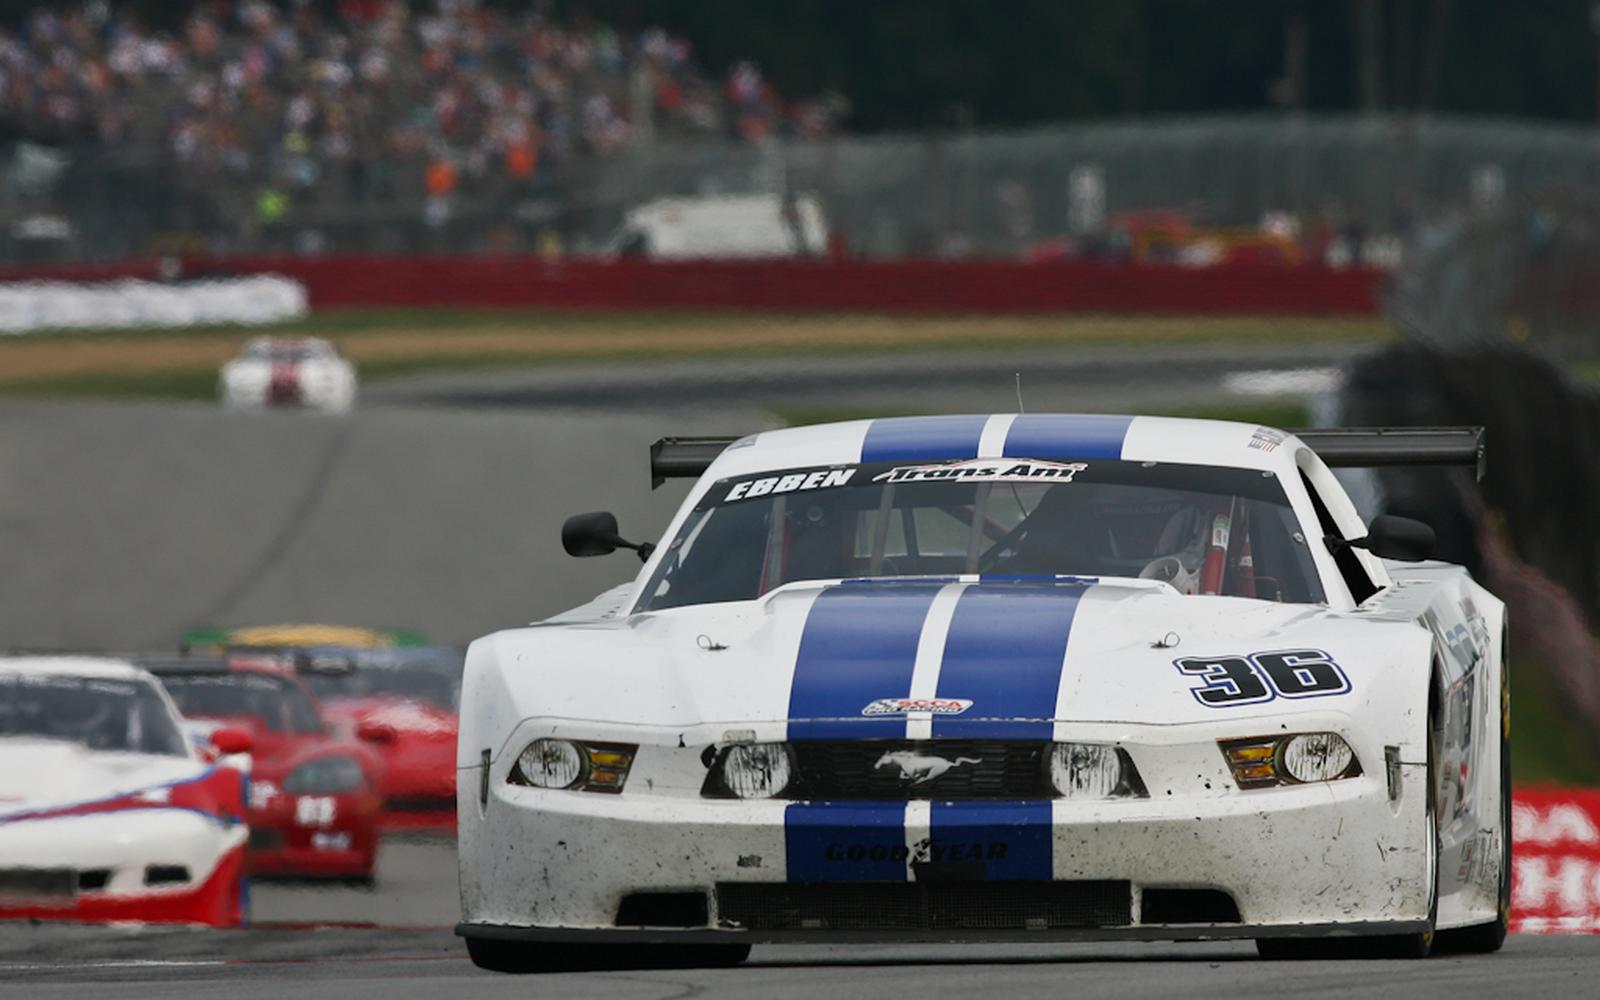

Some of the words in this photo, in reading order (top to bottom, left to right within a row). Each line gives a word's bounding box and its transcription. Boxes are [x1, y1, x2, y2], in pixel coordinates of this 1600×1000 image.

[724, 468, 856, 502] EBBEN
[882, 465, 997, 482] Trans
[999, 464, 1072, 478] Am
[1172, 648, 1352, 708] 36
[898, 699, 962, 709] SCCA
